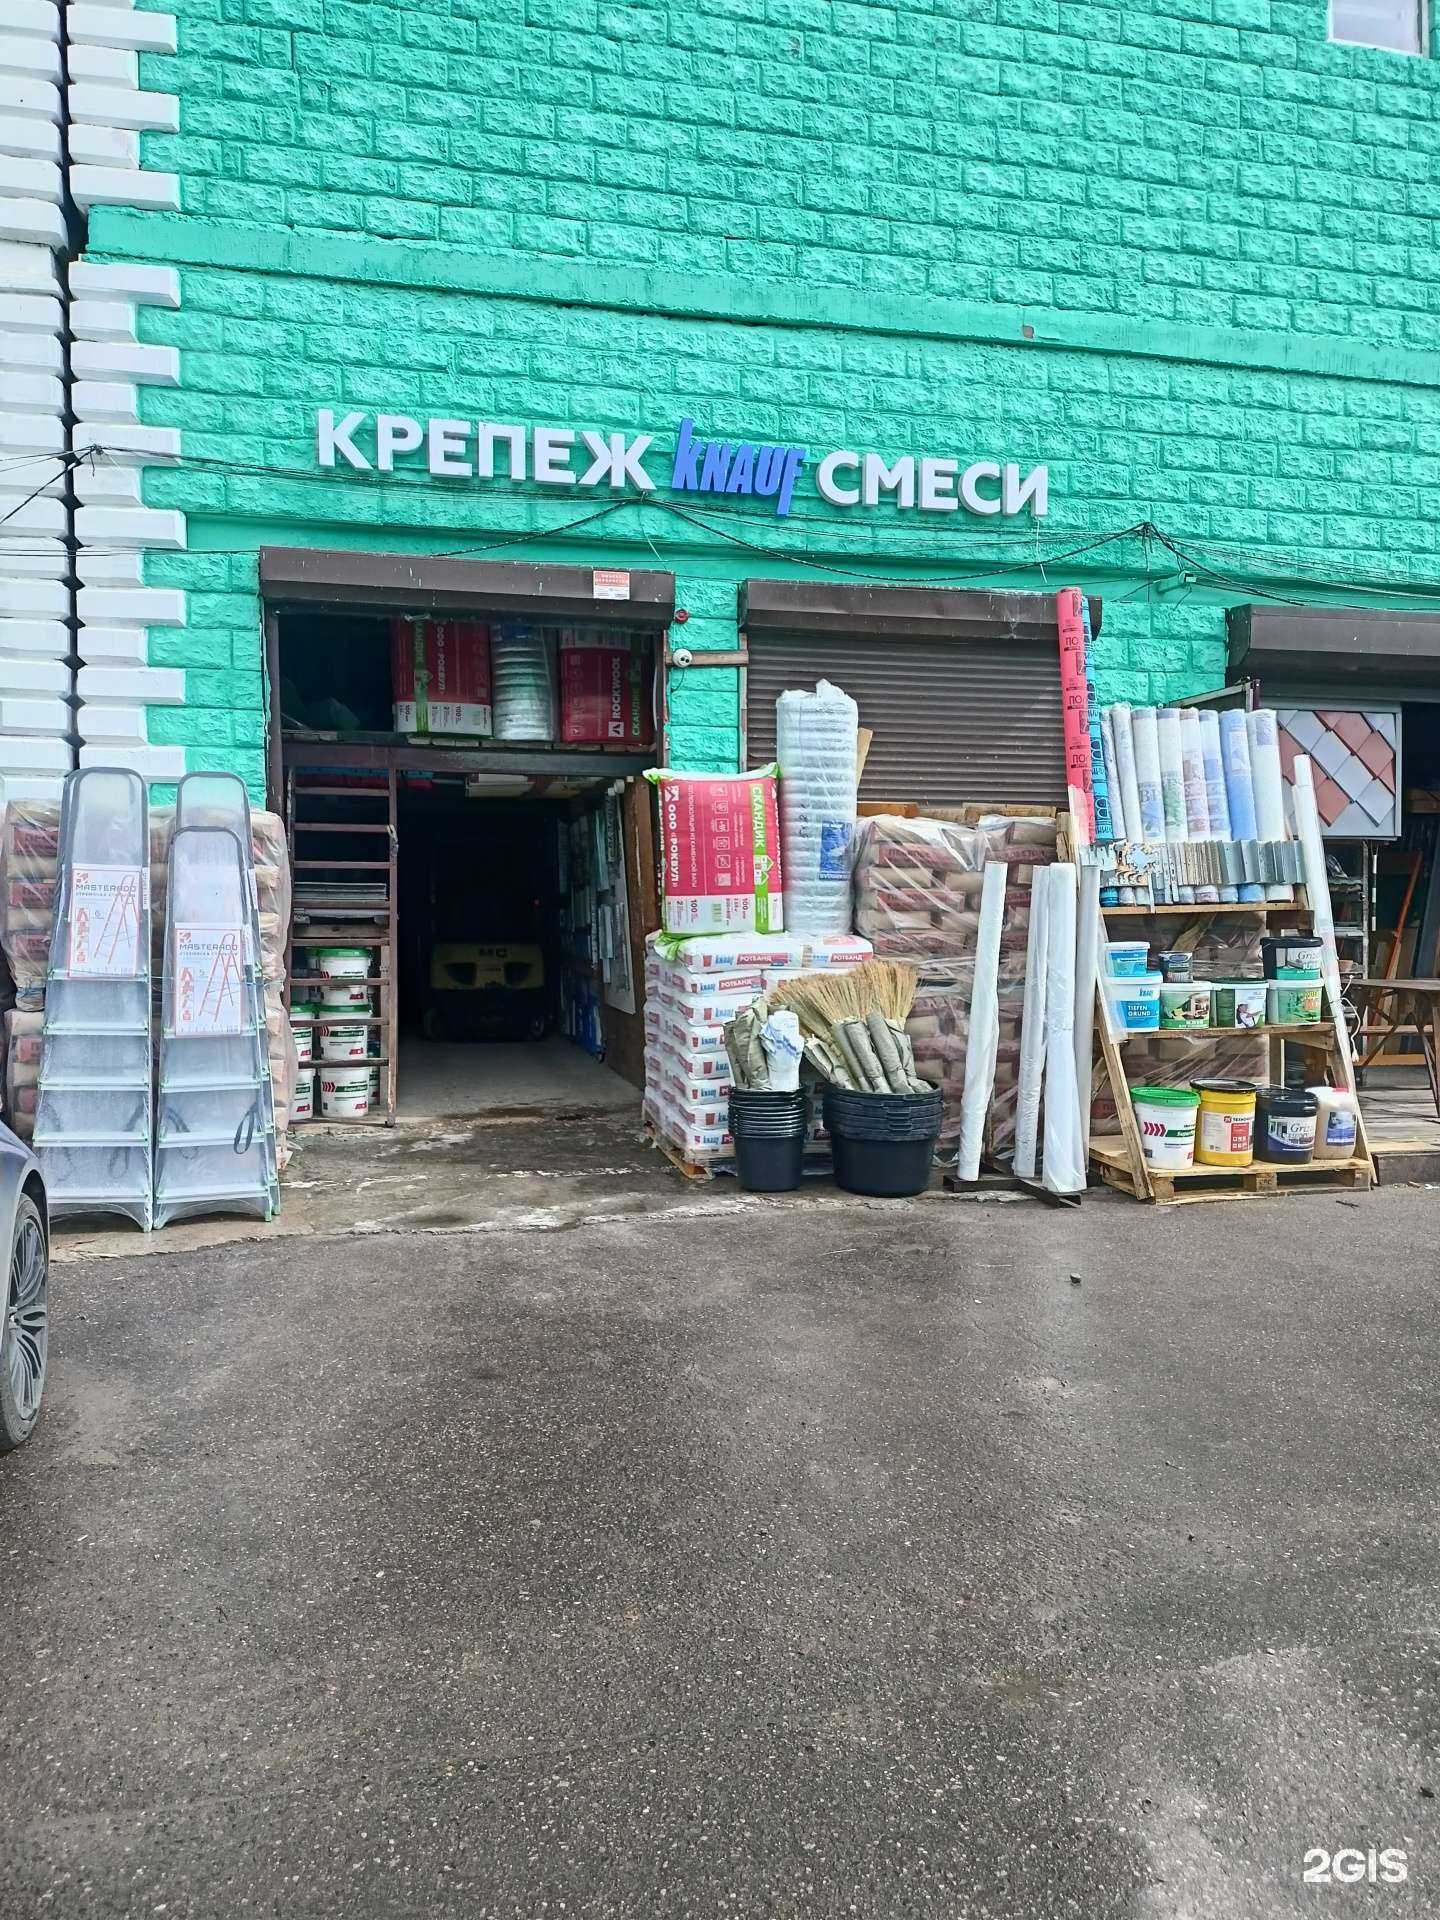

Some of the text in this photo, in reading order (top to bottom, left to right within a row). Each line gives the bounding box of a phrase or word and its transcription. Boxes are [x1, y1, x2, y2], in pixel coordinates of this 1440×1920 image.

[317, 408, 657, 491] КРЕПЕЖ
[816, 450, 1049, 517] СМЕСИ
[612, 656, 622, 719] ROCKWOOL
[668, 804, 678, 830] ООО
[751, 786, 765, 848] СКАНДИК
[76, 884, 137, 893] MASTERADO
[833, 954, 863, 962] РОТБАНД
